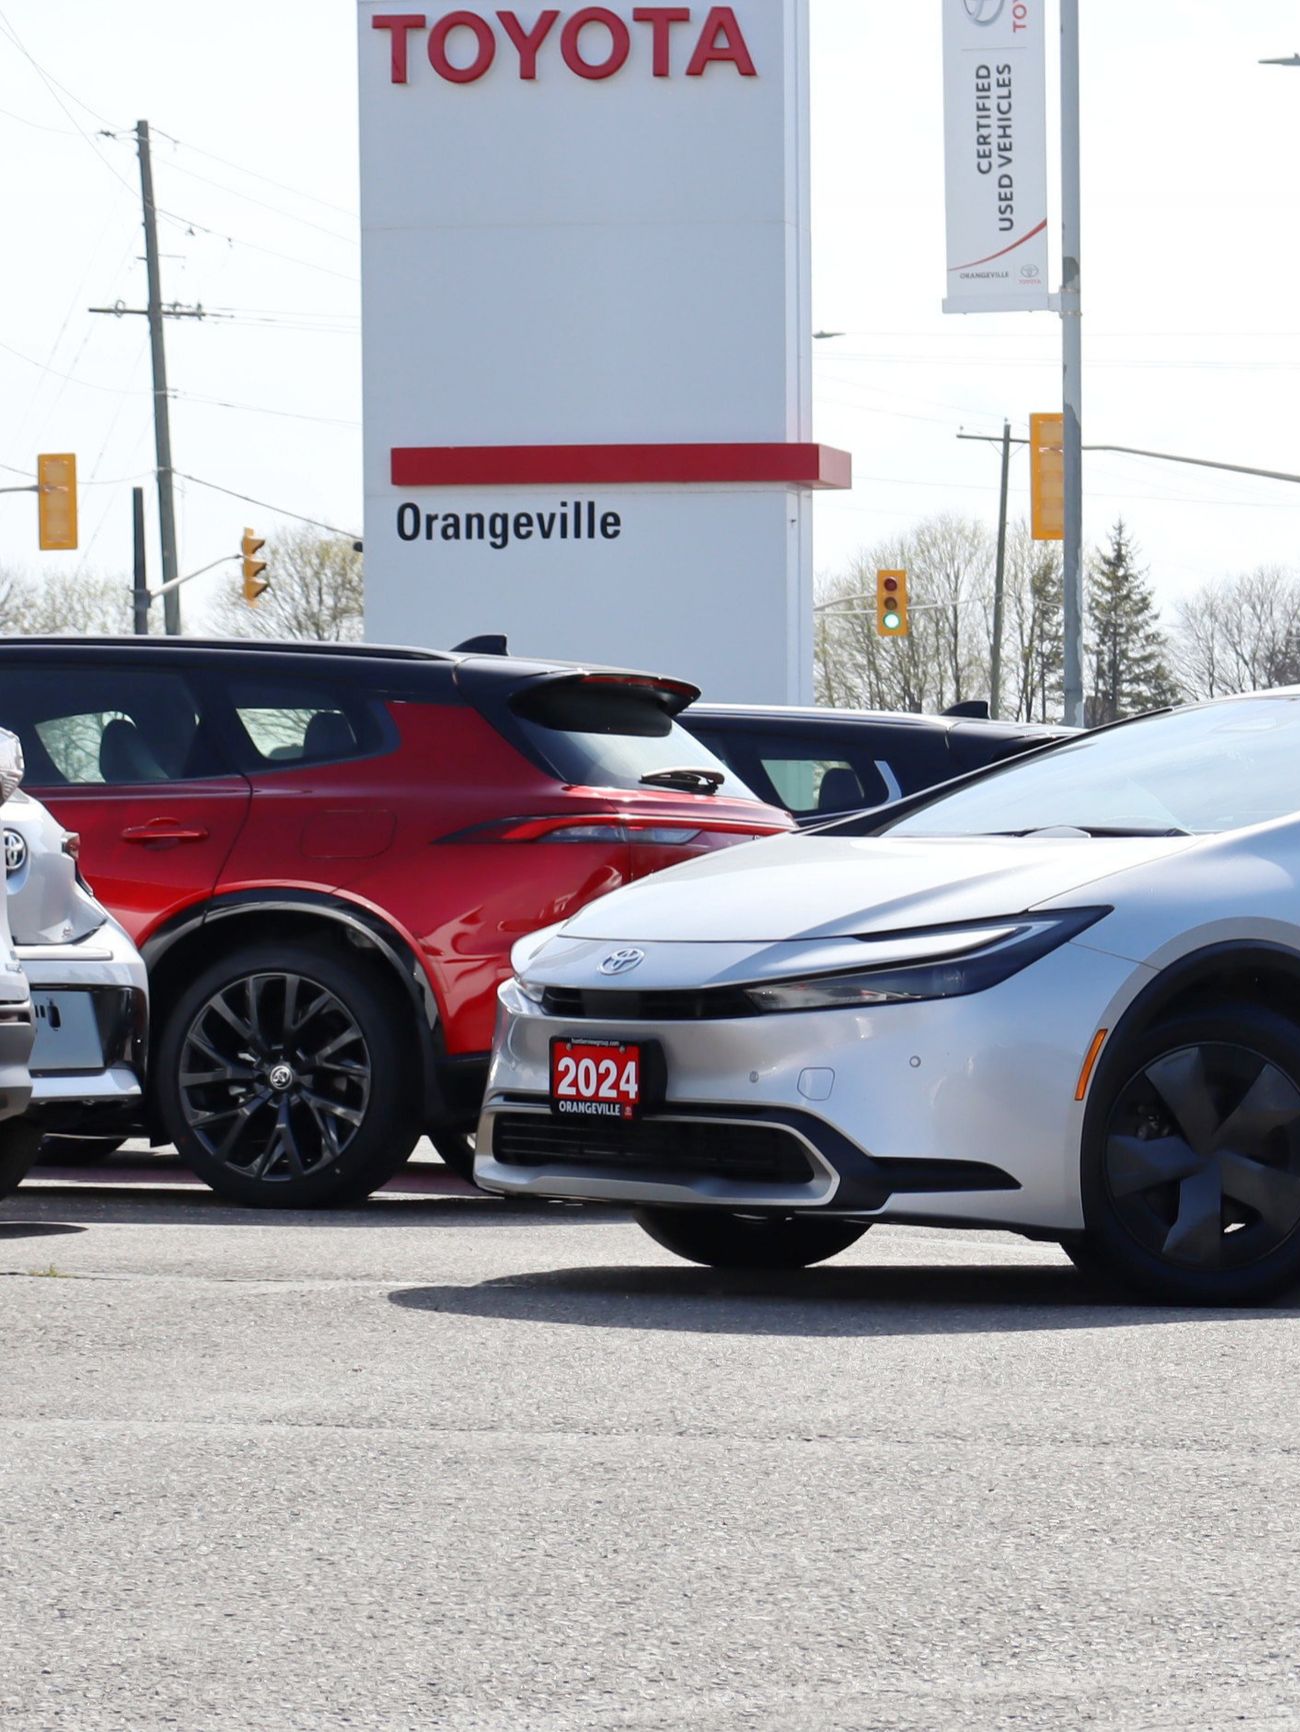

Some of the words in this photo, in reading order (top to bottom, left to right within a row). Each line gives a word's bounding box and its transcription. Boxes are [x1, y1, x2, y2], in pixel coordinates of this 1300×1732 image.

[1012, 0, 1027, 33] TO
[372, 6, 758, 84] TOYOTA
[976, 64, 992, 175] CERTIFIED
[997, 64, 1012, 167] VEHICLES
[998, 174, 1014, 231] USED
[396, 501, 622, 550] Orangeville
[557, 1057, 638, 1099] 2024
[559, 1100, 621, 1116] ORANGEVILLE
